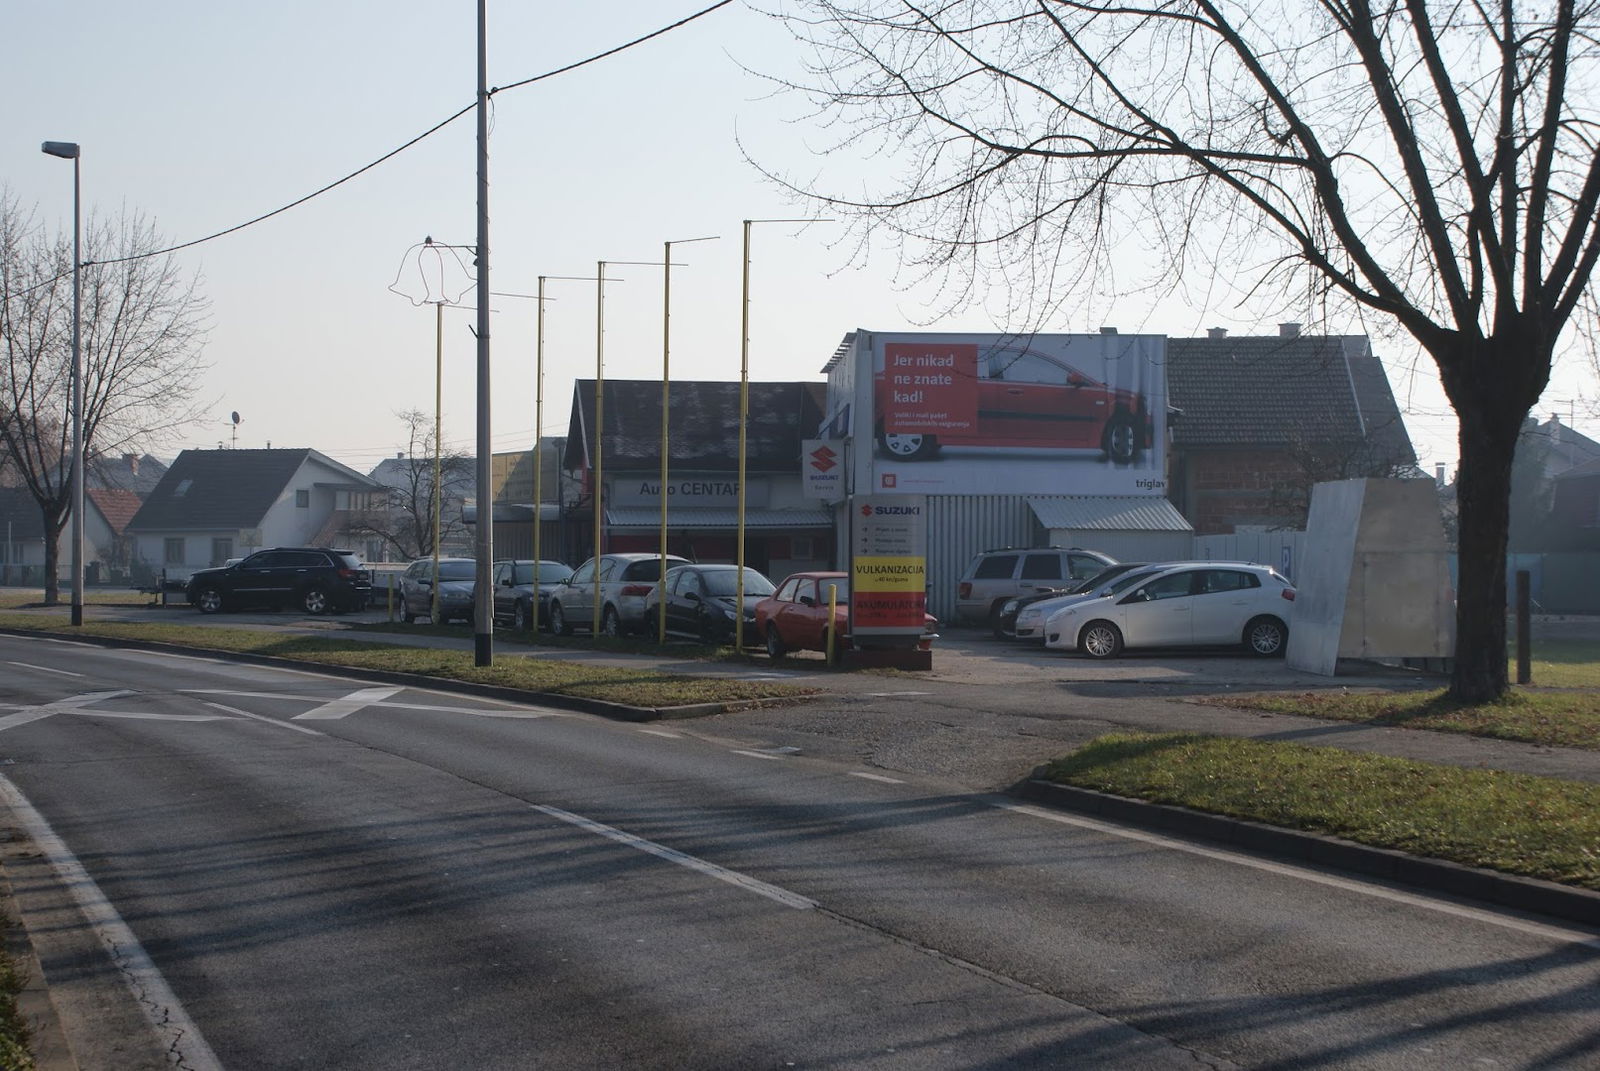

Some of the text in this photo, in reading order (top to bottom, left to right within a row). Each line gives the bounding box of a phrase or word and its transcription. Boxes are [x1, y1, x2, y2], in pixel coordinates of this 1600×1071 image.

[893, 354, 954, 367] Jer nikad
[894, 374, 953, 385] ne znate
[894, 391, 923, 403] kad!
[640, 482, 676, 496] Auo
[875, 506, 920, 515] SUZUKI
[856, 565, 924, 575] VULKANIZACIJA
